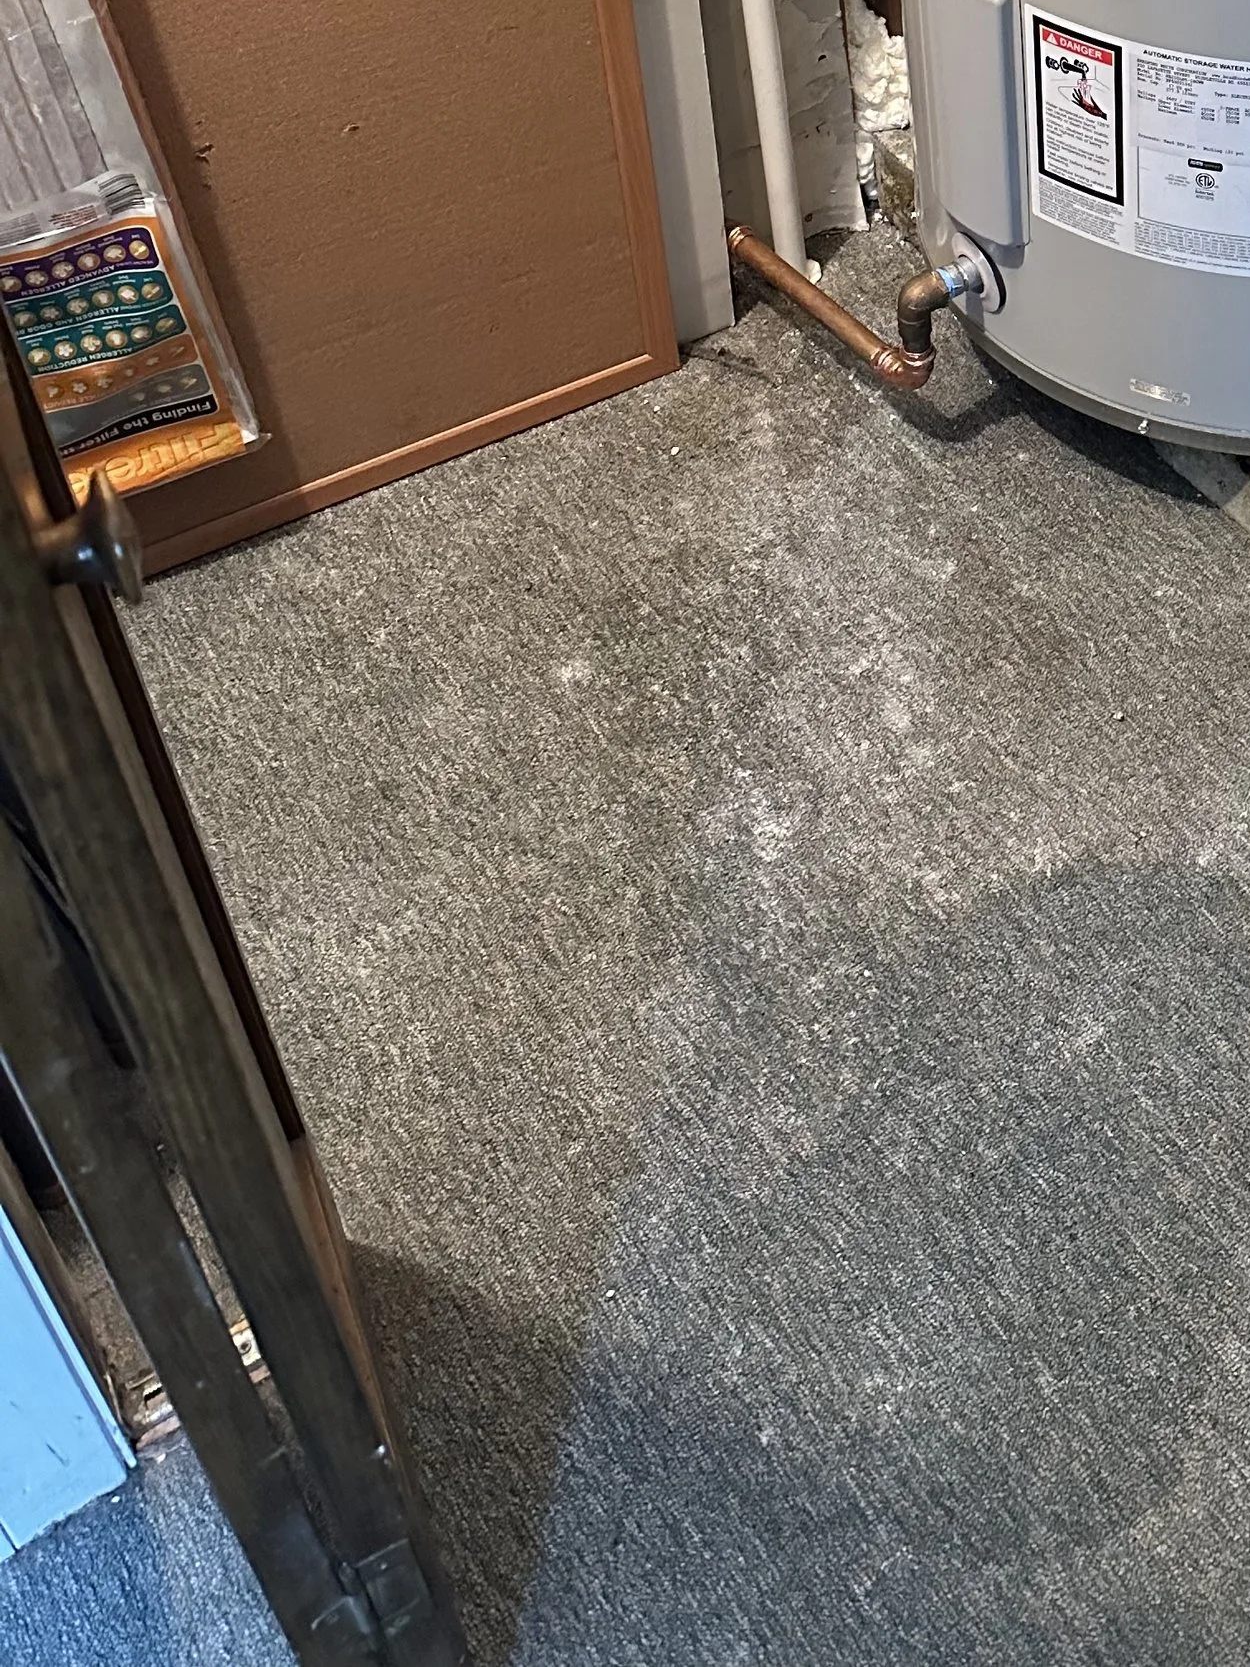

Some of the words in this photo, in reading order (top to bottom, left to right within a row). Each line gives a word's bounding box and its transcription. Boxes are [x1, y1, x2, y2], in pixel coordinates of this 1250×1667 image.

[1059, 37, 1103, 61] DANGER
[1143, 49, 1183, 62] AUTOMATIC
[1184, 58, 1218, 68] STORAGE
[1219, 63, 1245, 72] WATER
[69, 265, 115, 284] ADVANCED
[20, 278, 68, 296] ALLERGEN
[54, 317, 74, 327] AND
[75, 306, 120, 322] ALLERGEN
[28, 322, 54, 334] ODOR
[38, 356, 88, 372] REDUCTION
[89, 348, 133, 362] ALLERGEN
[152, 401, 211, 421] Finding
[123, 417, 149, 431] the
[83, 428, 120, 450] Filter
[68, 422, 238, 494] Filtree
